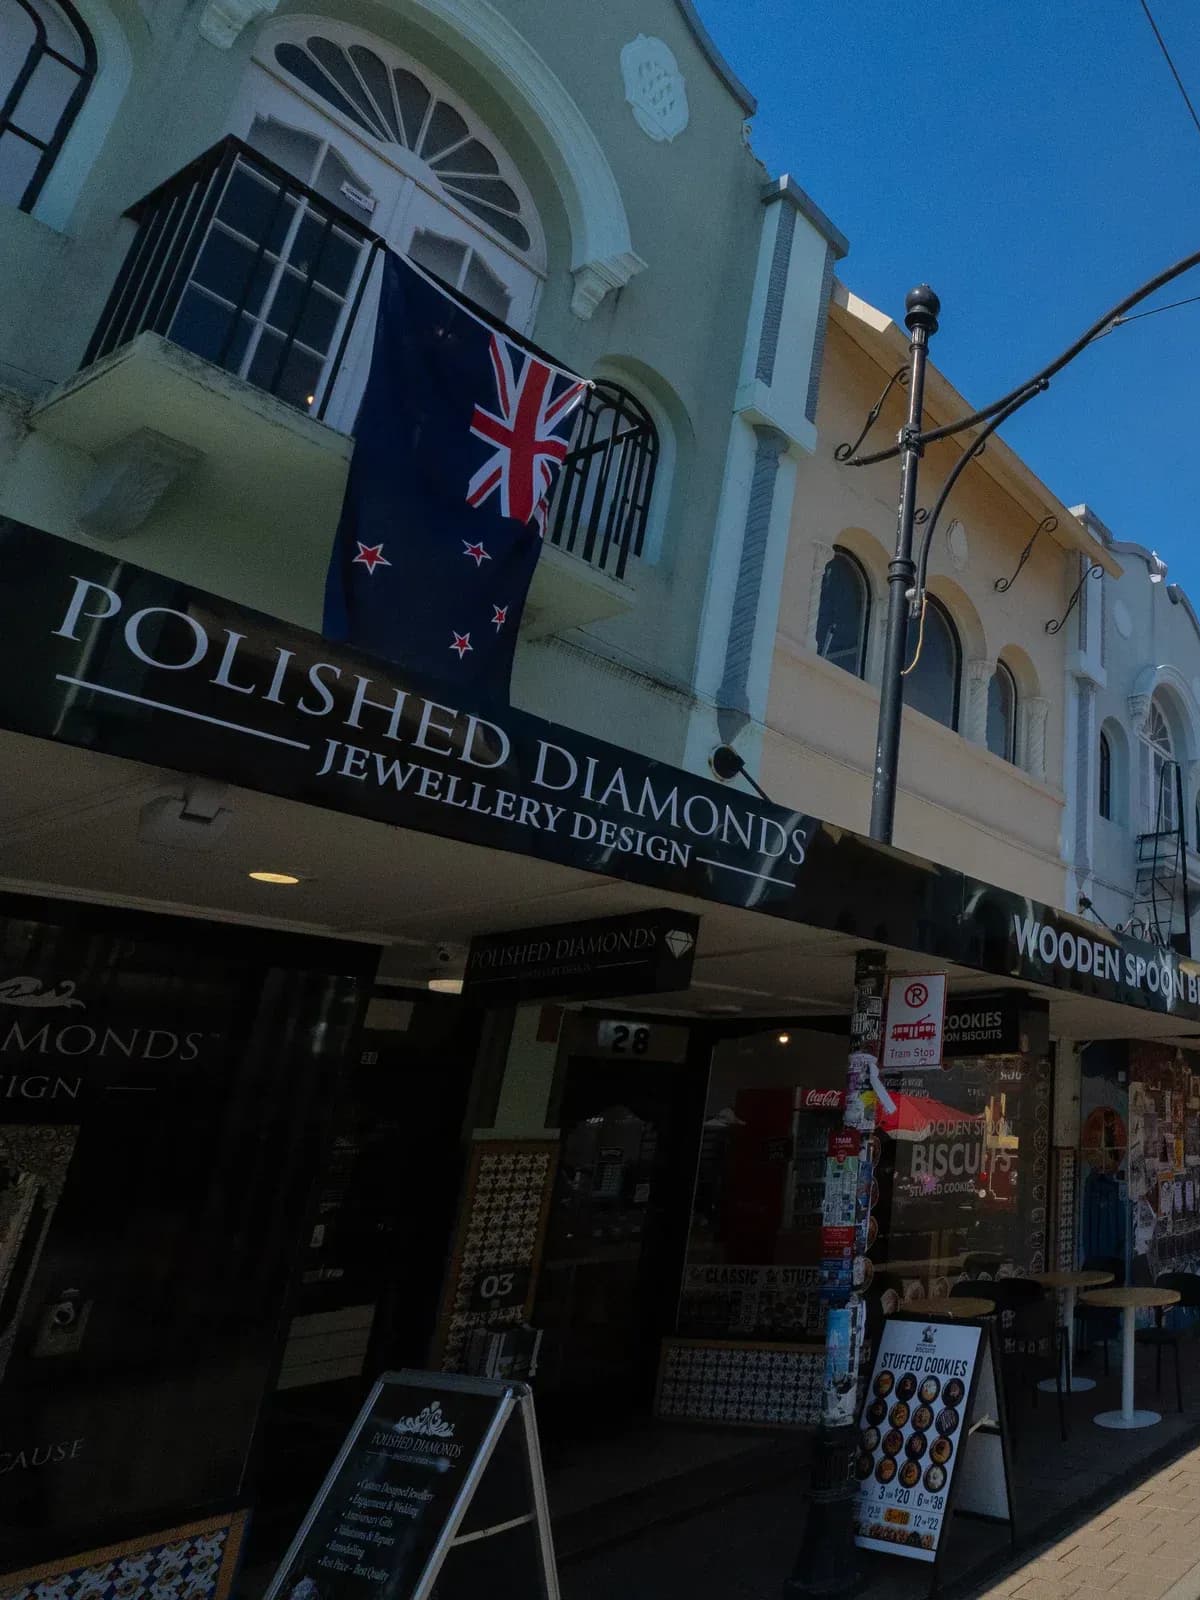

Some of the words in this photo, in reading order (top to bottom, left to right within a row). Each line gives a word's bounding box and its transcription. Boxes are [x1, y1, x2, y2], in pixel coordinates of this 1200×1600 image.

[51, 576, 511, 769] POLISHED
[533, 739, 808, 865] DIAMONDS
[316, 739, 565, 832] JEWELLERY
[569, 811, 692, 869] DESIGN
[471, 942, 553, 969] POLISHED
[555, 926, 657, 961] DIAMONDS
[1013, 914, 1119, 983] WOODEN
[1125, 952, 1184, 1000] SPOON
[612, 1025, 649, 1053] 28
[962, 1028, 1002, 1041] BISCUITS
[890, 1049, 911, 1059] Tram
[914, 1047, 935, 1058] Stop
[0, 1074, 84, 1100] IGN
[914, 1119, 970, 1137] WOODEN
[975, 1119, 1013, 1136] SPOON
[911, 1142, 1012, 1177] BISCUITS
[944, 1180, 976, 1193] COOKIES
[481, 1272, 515, 1298] 03
[706, 1269, 759, 1284] CLASSIC
[881, 1352, 923, 1372] STUFFED
[924, 1357, 968, 1377] COOKIES
[371, 1431, 413, 1450] POLISHED
[414, 1438, 463, 1458] DIAMONDS
[878, 1485, 885, 1500] 3
[895, 1488, 910, 1504] $20
[917, 1493, 924, 1507] 6
[913, 1514, 922, 1528] 12
